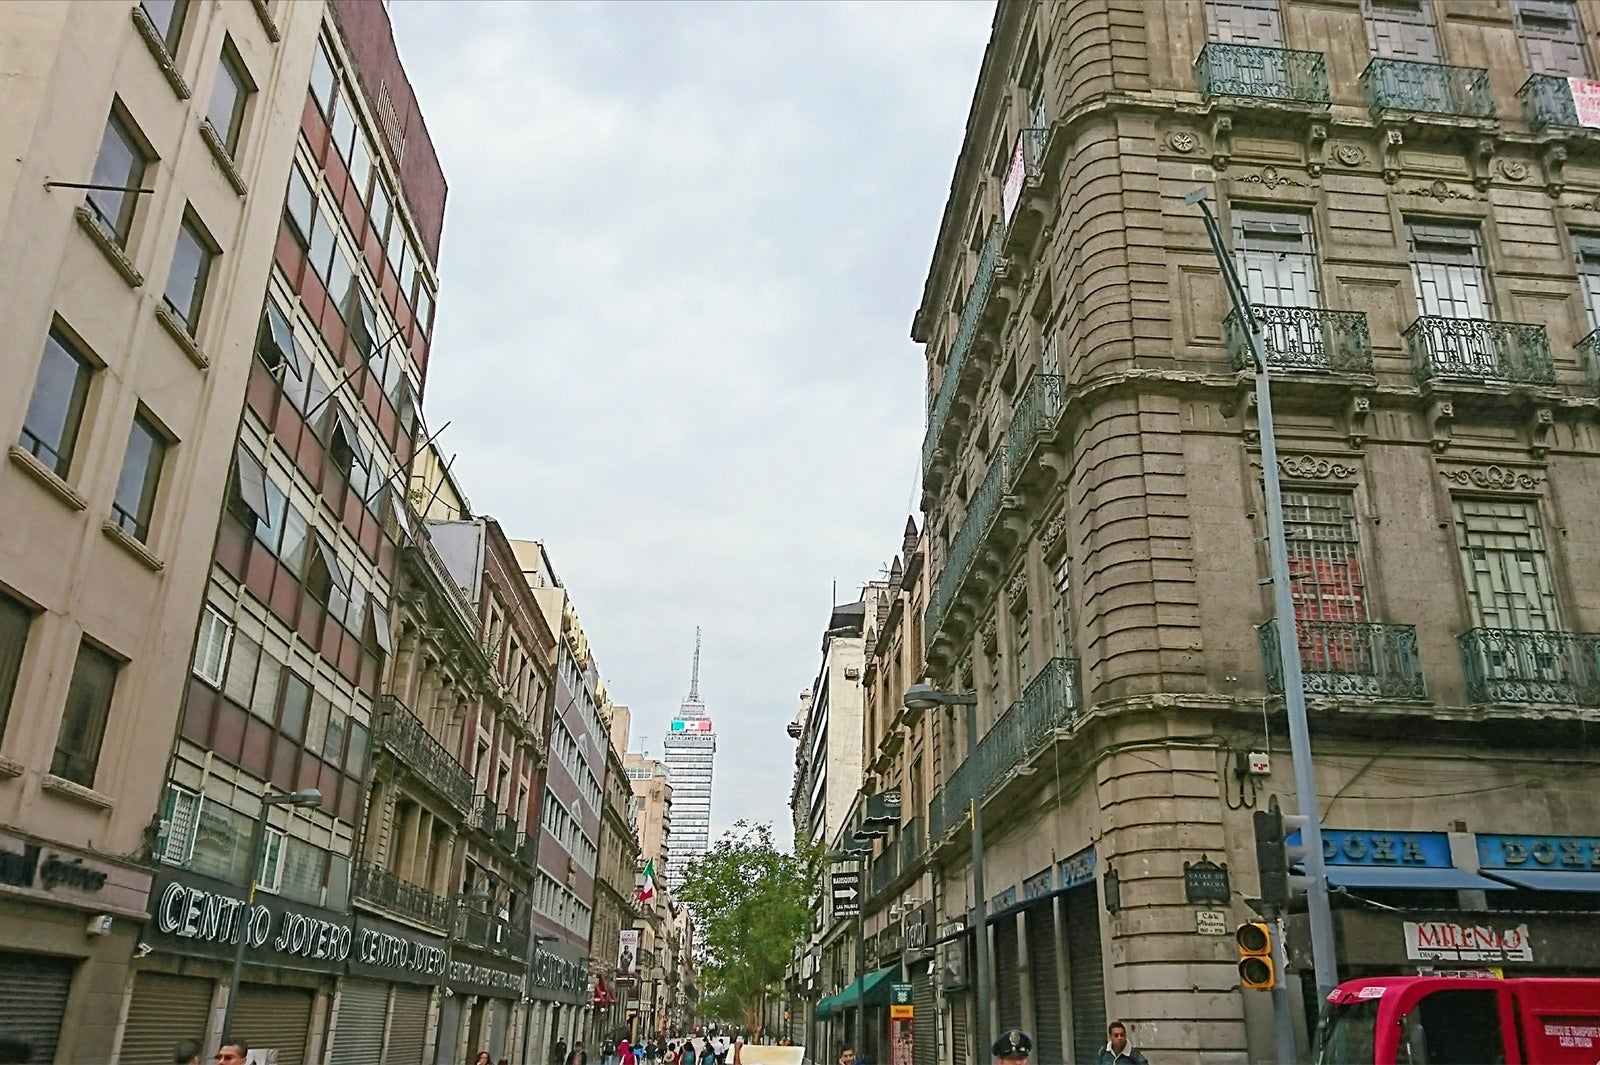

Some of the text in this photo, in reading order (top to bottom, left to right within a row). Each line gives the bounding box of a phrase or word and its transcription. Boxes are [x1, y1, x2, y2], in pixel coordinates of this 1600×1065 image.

[1322, 835, 1426, 862] DOXA
[275, 911, 352, 961] JOYERO
[358, 927, 447, 977] CENTRO JOYERO
